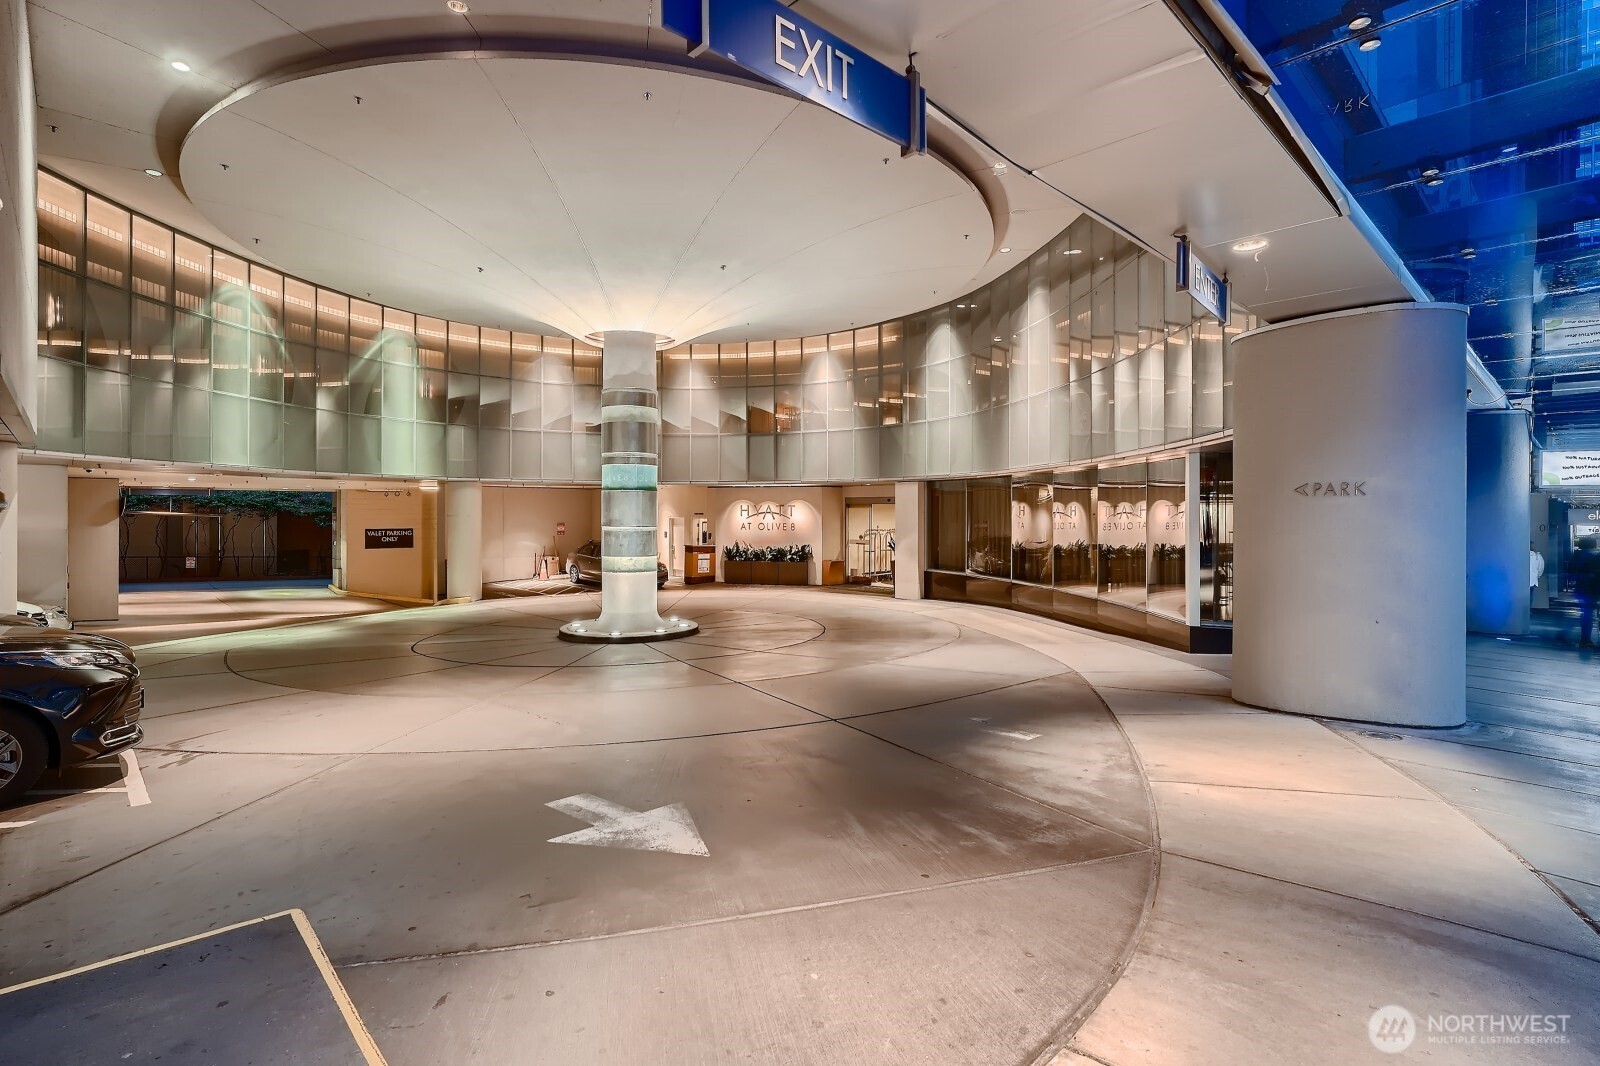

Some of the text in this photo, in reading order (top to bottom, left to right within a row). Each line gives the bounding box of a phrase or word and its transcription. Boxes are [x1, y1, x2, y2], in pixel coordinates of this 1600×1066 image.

[775, 14, 854, 100] EXIT
[1195, 263, 1220, 309] ENTER
[740, 504, 795, 520] HYATT
[757, 522, 787, 531] OLIVE
[791, 523, 796, 531] 8
